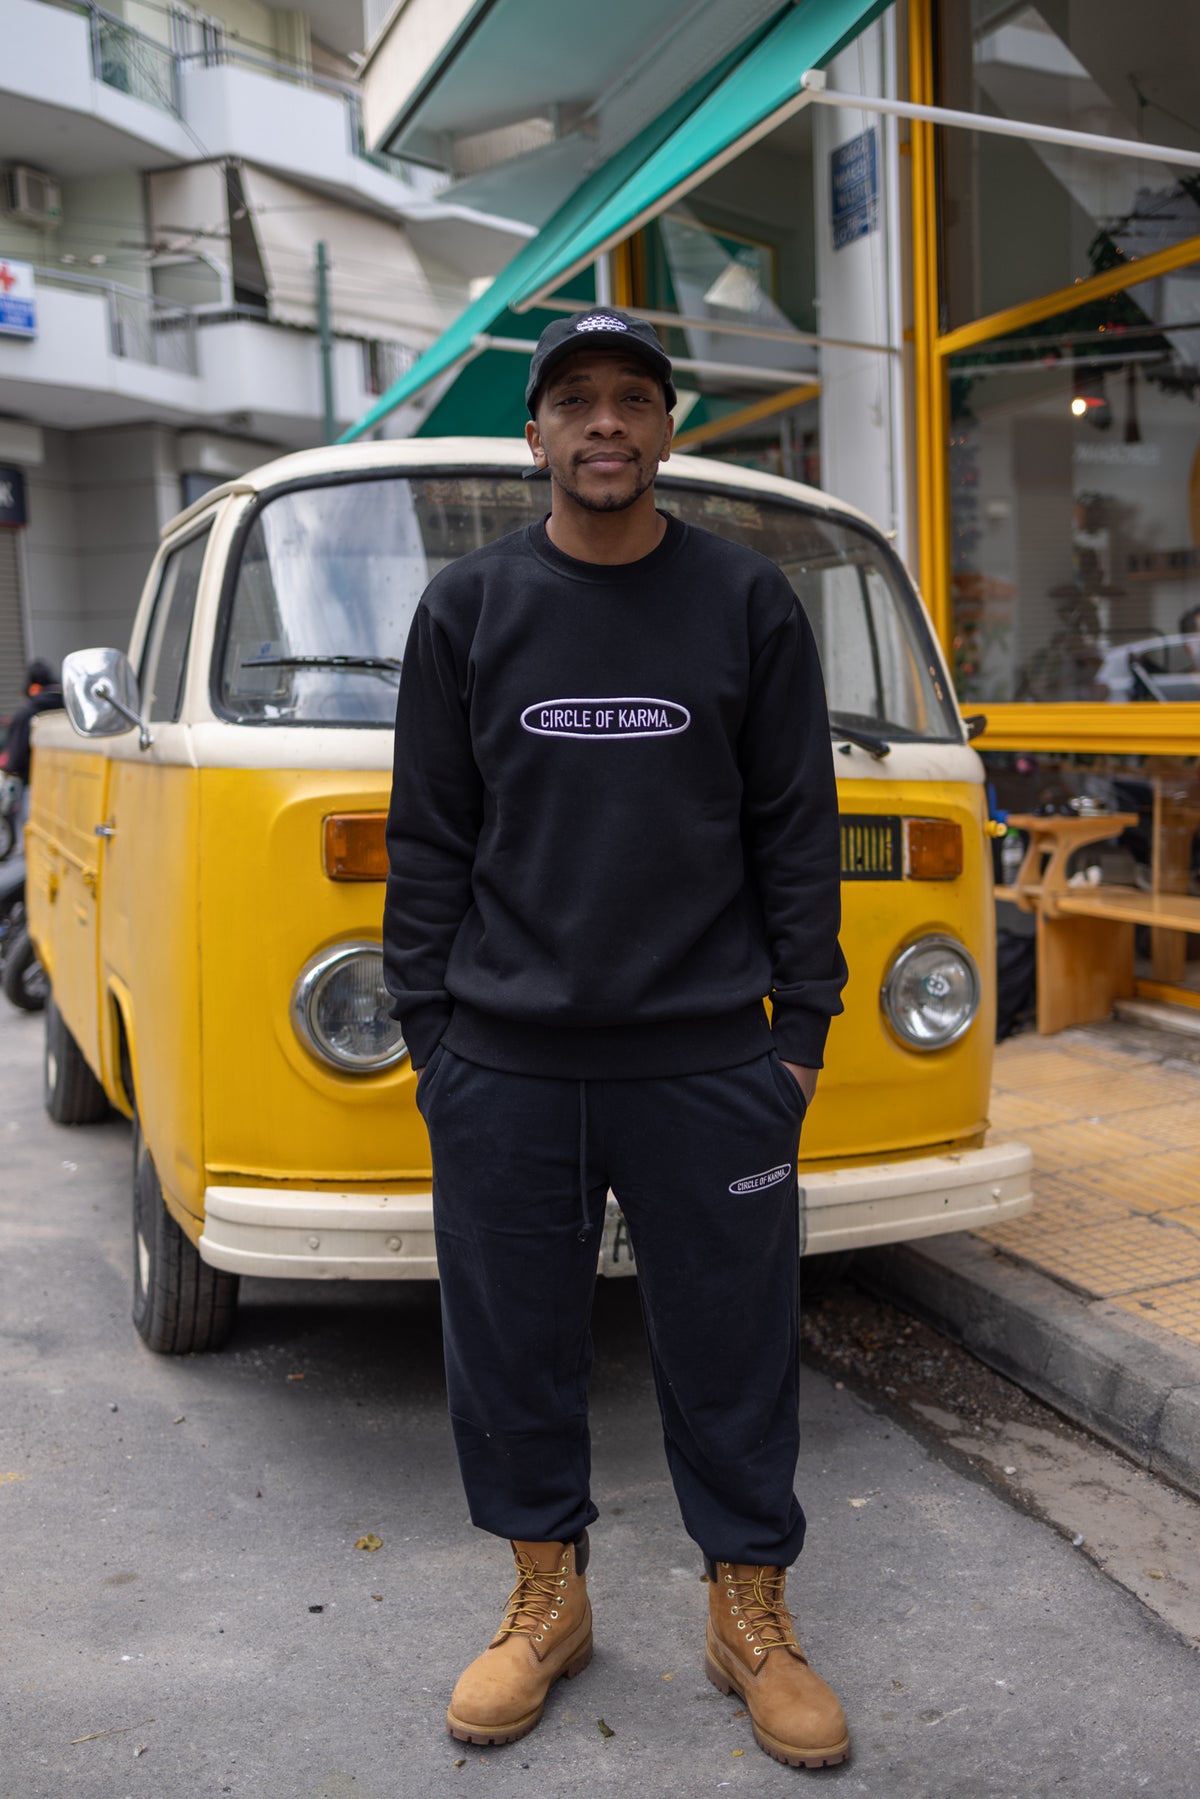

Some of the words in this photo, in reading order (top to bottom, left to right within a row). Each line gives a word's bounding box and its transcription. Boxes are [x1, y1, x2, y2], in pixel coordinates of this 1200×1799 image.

[540, 709, 591, 728] CIRCLE
[595, 710, 614, 729] OF
[619, 708, 672, 728] KARMA.
[737, 1178, 759, 1191] CIRCLE
[759, 1175, 768, 1186] OF
